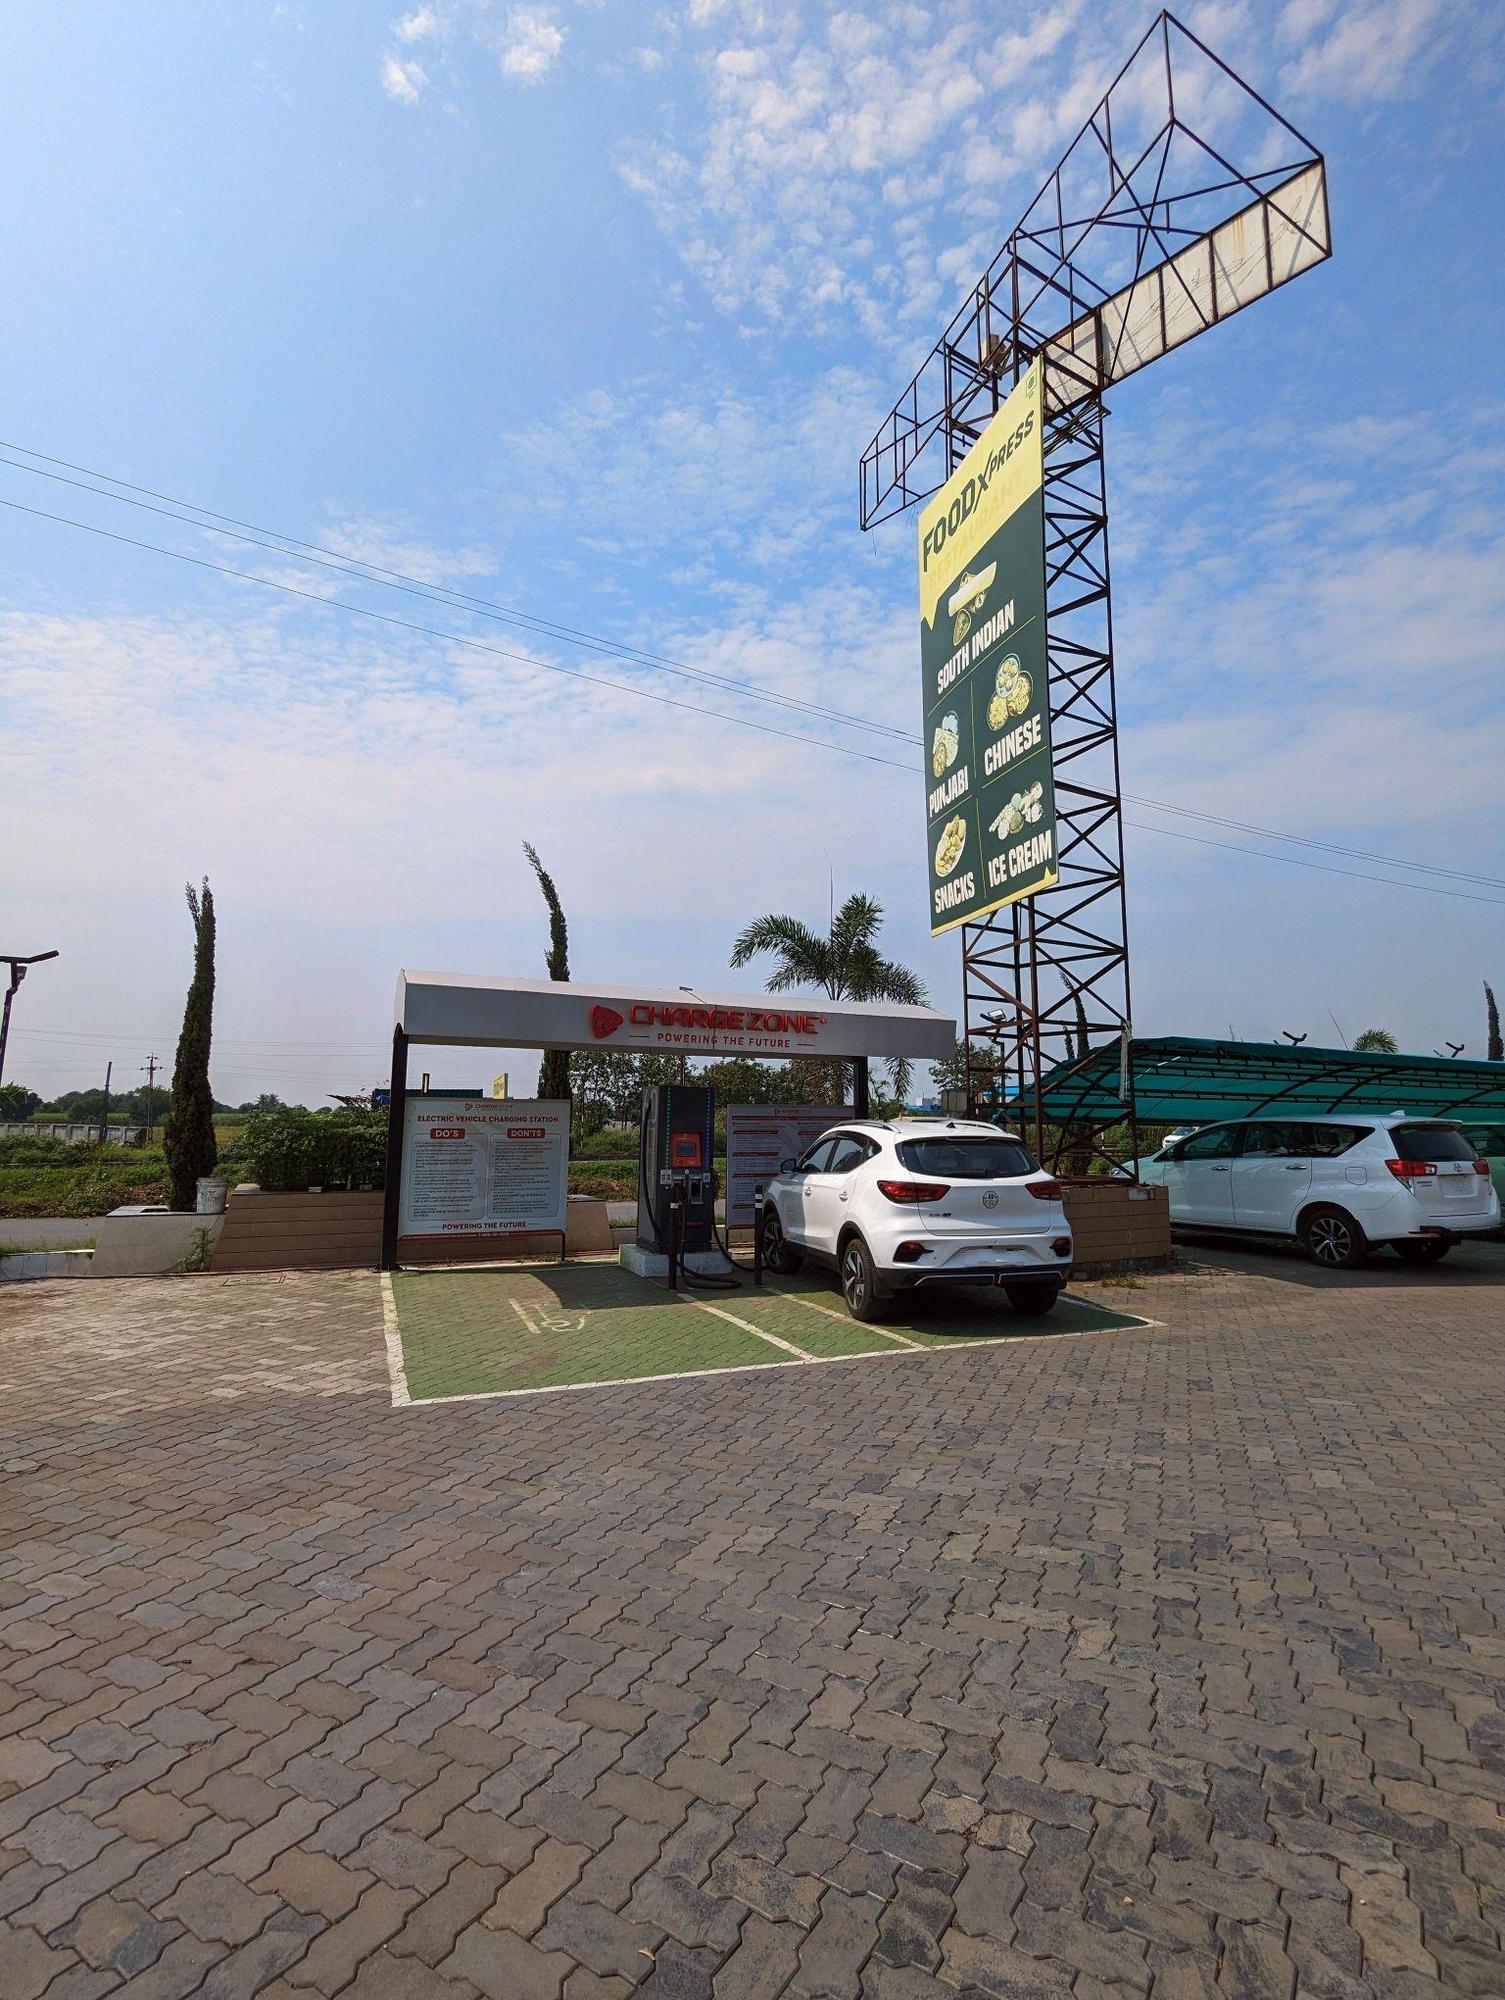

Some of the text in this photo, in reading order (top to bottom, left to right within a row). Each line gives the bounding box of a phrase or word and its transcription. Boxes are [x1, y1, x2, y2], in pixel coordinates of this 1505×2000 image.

[937, 599, 1015, 695] SOUTH INDIAN
[984, 713, 1042, 777] CHINESE
[929, 765, 969, 819] PUNJABI
[988, 830, 1052, 889] ICE CREAM
[935, 872, 975, 914] SNACKS
[657, 1033, 791, 1048] POWERING THE FUTURE
[417, 1115, 455, 1123] ELECTRIC
[456, 1115, 487, 1123] VEHICLE
[435, 1130, 460, 1138] DO'S
[499, 1221, 527, 1229] FUTURE
